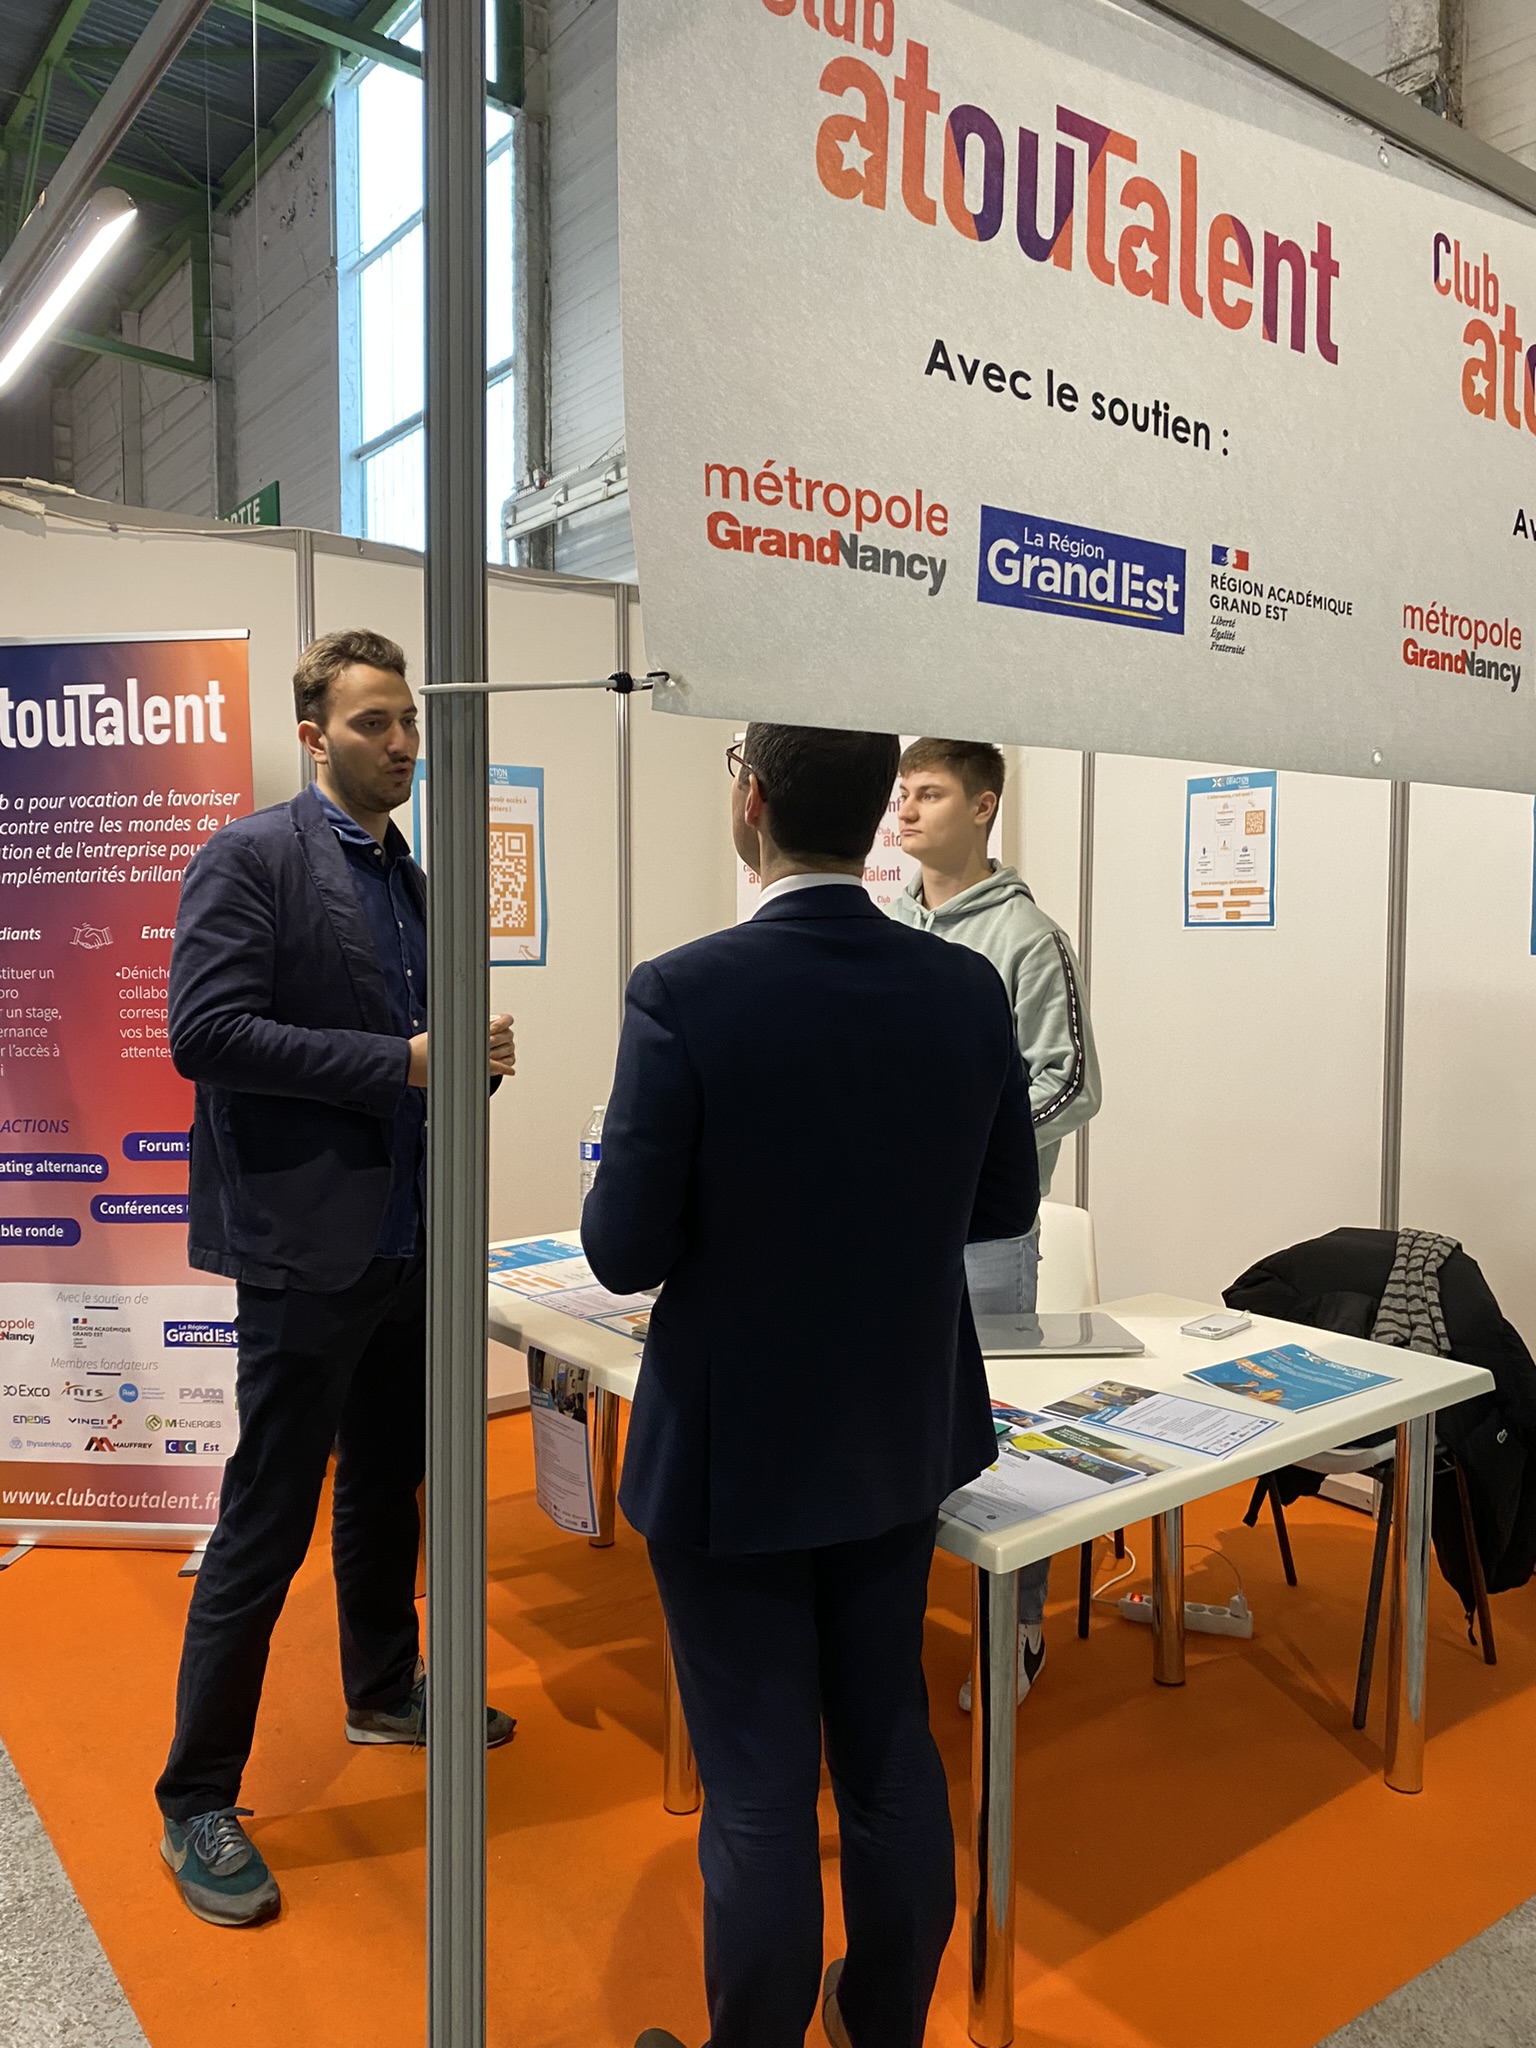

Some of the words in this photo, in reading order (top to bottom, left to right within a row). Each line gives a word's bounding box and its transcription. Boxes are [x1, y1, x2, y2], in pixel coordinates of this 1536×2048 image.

[1433, 231, 1499, 317] Club
[924, 338, 1033, 401] Avec
[1046, 368, 1079, 412] le
[1090, 399, 1211, 451] soutien
[703, 458, 949, 537] métropole
[1023, 526, 1046, 546] La
[1049, 532, 1105, 560] Région
[1210, 572, 1264, 598] RÉGION
[1267, 586, 1353, 616] ACADÉMIQUE
[1209, 594, 1262, 617] GRAND
[1265, 604, 1288, 622] EST
[1210, 615, 1236, 628] Liberté
[1403, 601, 1522, 650] métropole
[1210, 627, 1236, 641] Égalité
[1210, 641, 1246, 655] Fraternité
[14, 797, 24, 810] a
[28, 796, 65, 814] pour
[69, 791, 138, 809] vocation
[142, 790, 162, 807] de
[167, 789, 241, 807] favoriser
[54, 818, 94, 833] entre
[99, 816, 123, 833] les
[128, 815, 192, 832] mondes
[197, 814, 219, 831] de
[36, 844, 51, 859] et
[55, 842, 73, 858] de
[39, 968, 54, 979] un
[6, 1008, 22, 1019] un
[25, 1008, 62, 1021] stage,
[119, 1029, 142, 1039] vos
[53, 1044, 60, 1057] à
[1, 1119, 70, 1134] ACTIONS
[139, 1140, 182, 1152] Forum
[36, 1161, 103, 1175] alternance
[100, 1200, 183, 1215] Conférences
[25, 1225, 64, 1238] ronde
[56, 1292, 80, 1303] Avec
[82, 1291, 92, 1303] le
[94, 1293, 131, 1305] soutien
[134, 1293, 149, 1305] de
[50, 1357, 98, 1369] Membres
[99, 1357, 159, 1371] fondateurs
[26, 1440, 72, 1449] thyssenkrupp
[203, 1443, 220, 1451] Est
[2, 1487, 220, 1510] www.clubatoutalent.fr
